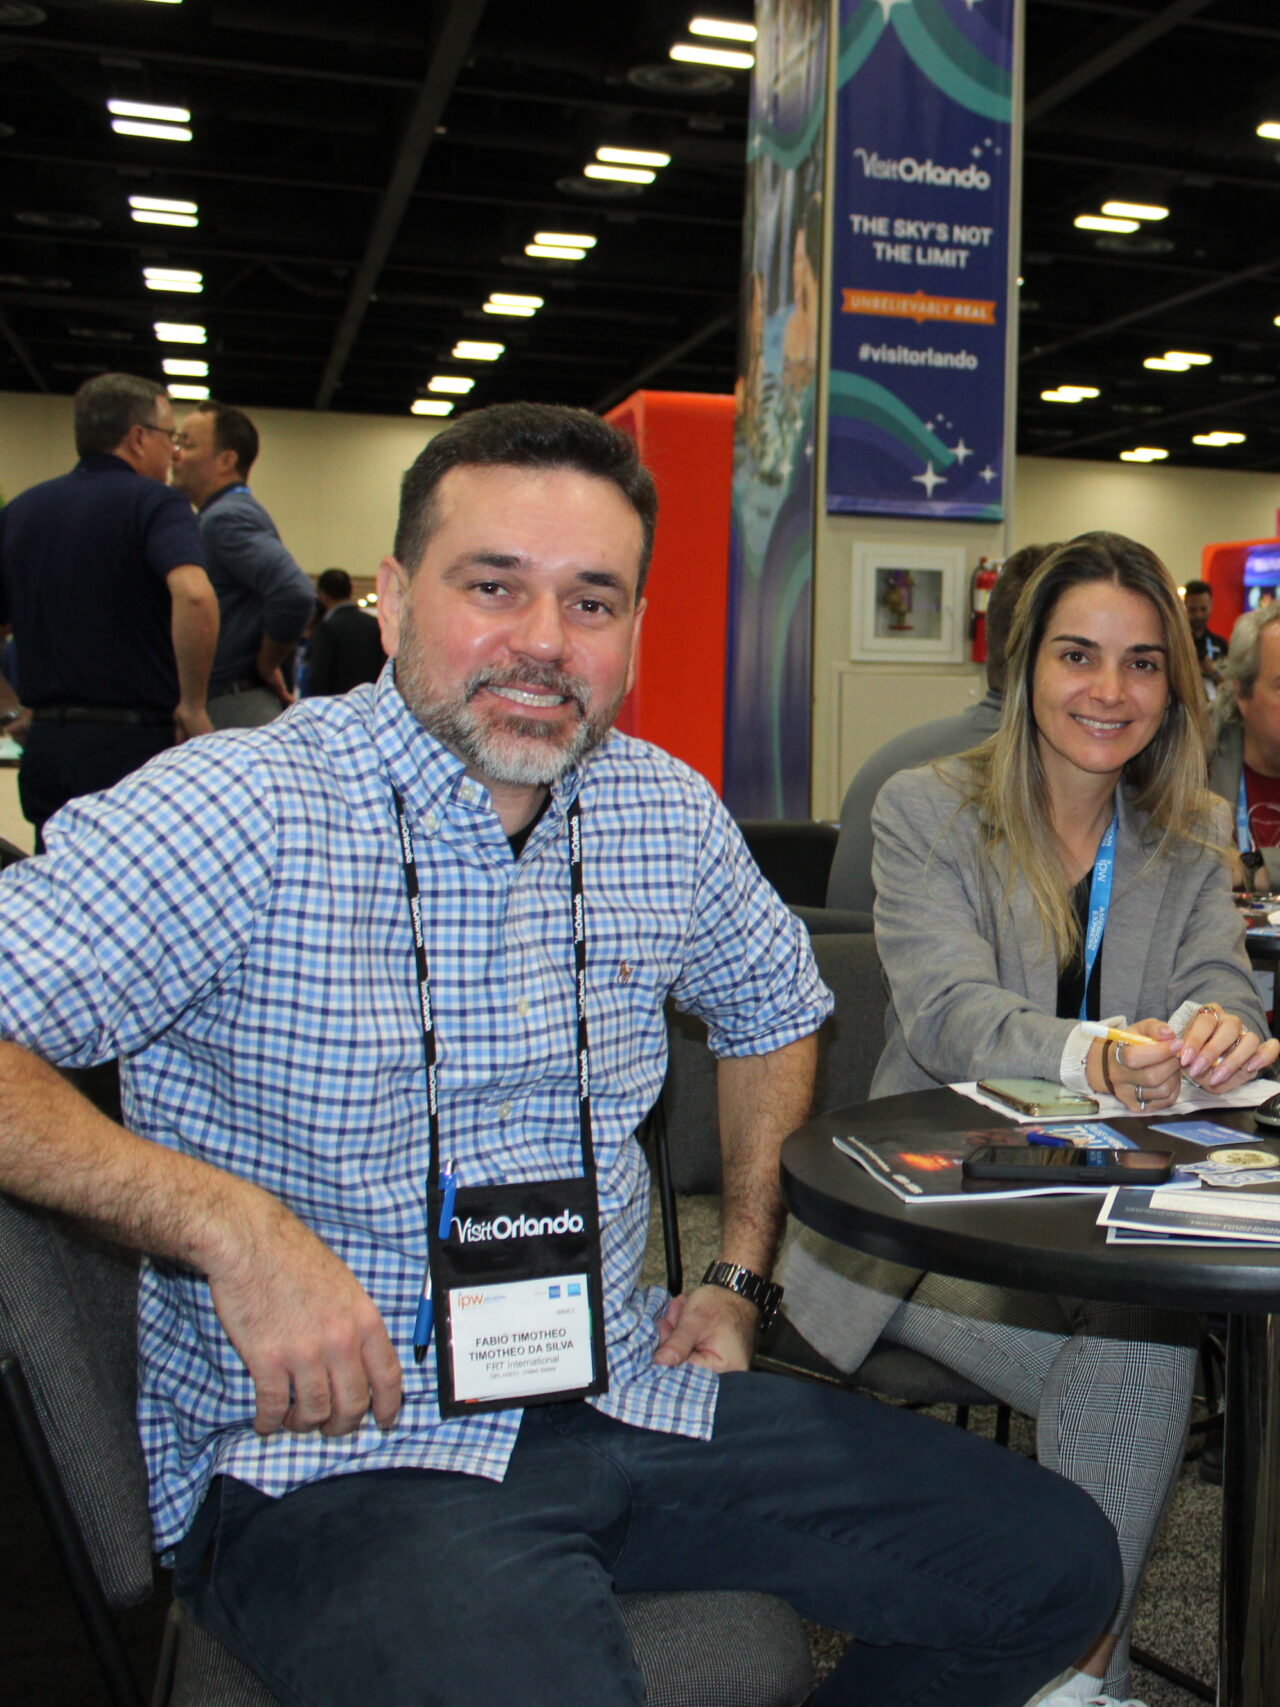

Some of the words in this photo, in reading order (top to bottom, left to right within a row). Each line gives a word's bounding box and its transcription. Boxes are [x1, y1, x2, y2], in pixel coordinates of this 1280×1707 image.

[850, 214, 889, 237] THE
[893, 218, 949, 242] SKY'S
[953, 225, 993, 246] NOT
[873, 242, 912, 264] THE
[916, 246, 970, 269] LIMIT
[851, 295, 951, 315] UNBELIEVABLY
[953, 302, 987, 320] REAL
[858, 343, 978, 370] #visitorlando
[451, 1208, 584, 1244] VisitOrlando
[458, 1291, 485, 1310] ipw
[475, 1335, 508, 1348] FABIO
[511, 1328, 567, 1343] TIMOTHEO
[469, 1345, 525, 1362] TIMOTHEO
[528, 1345, 544, 1355] DA
[546, 1340, 575, 1352] SILVA
[507, 1355, 560, 1370] International
